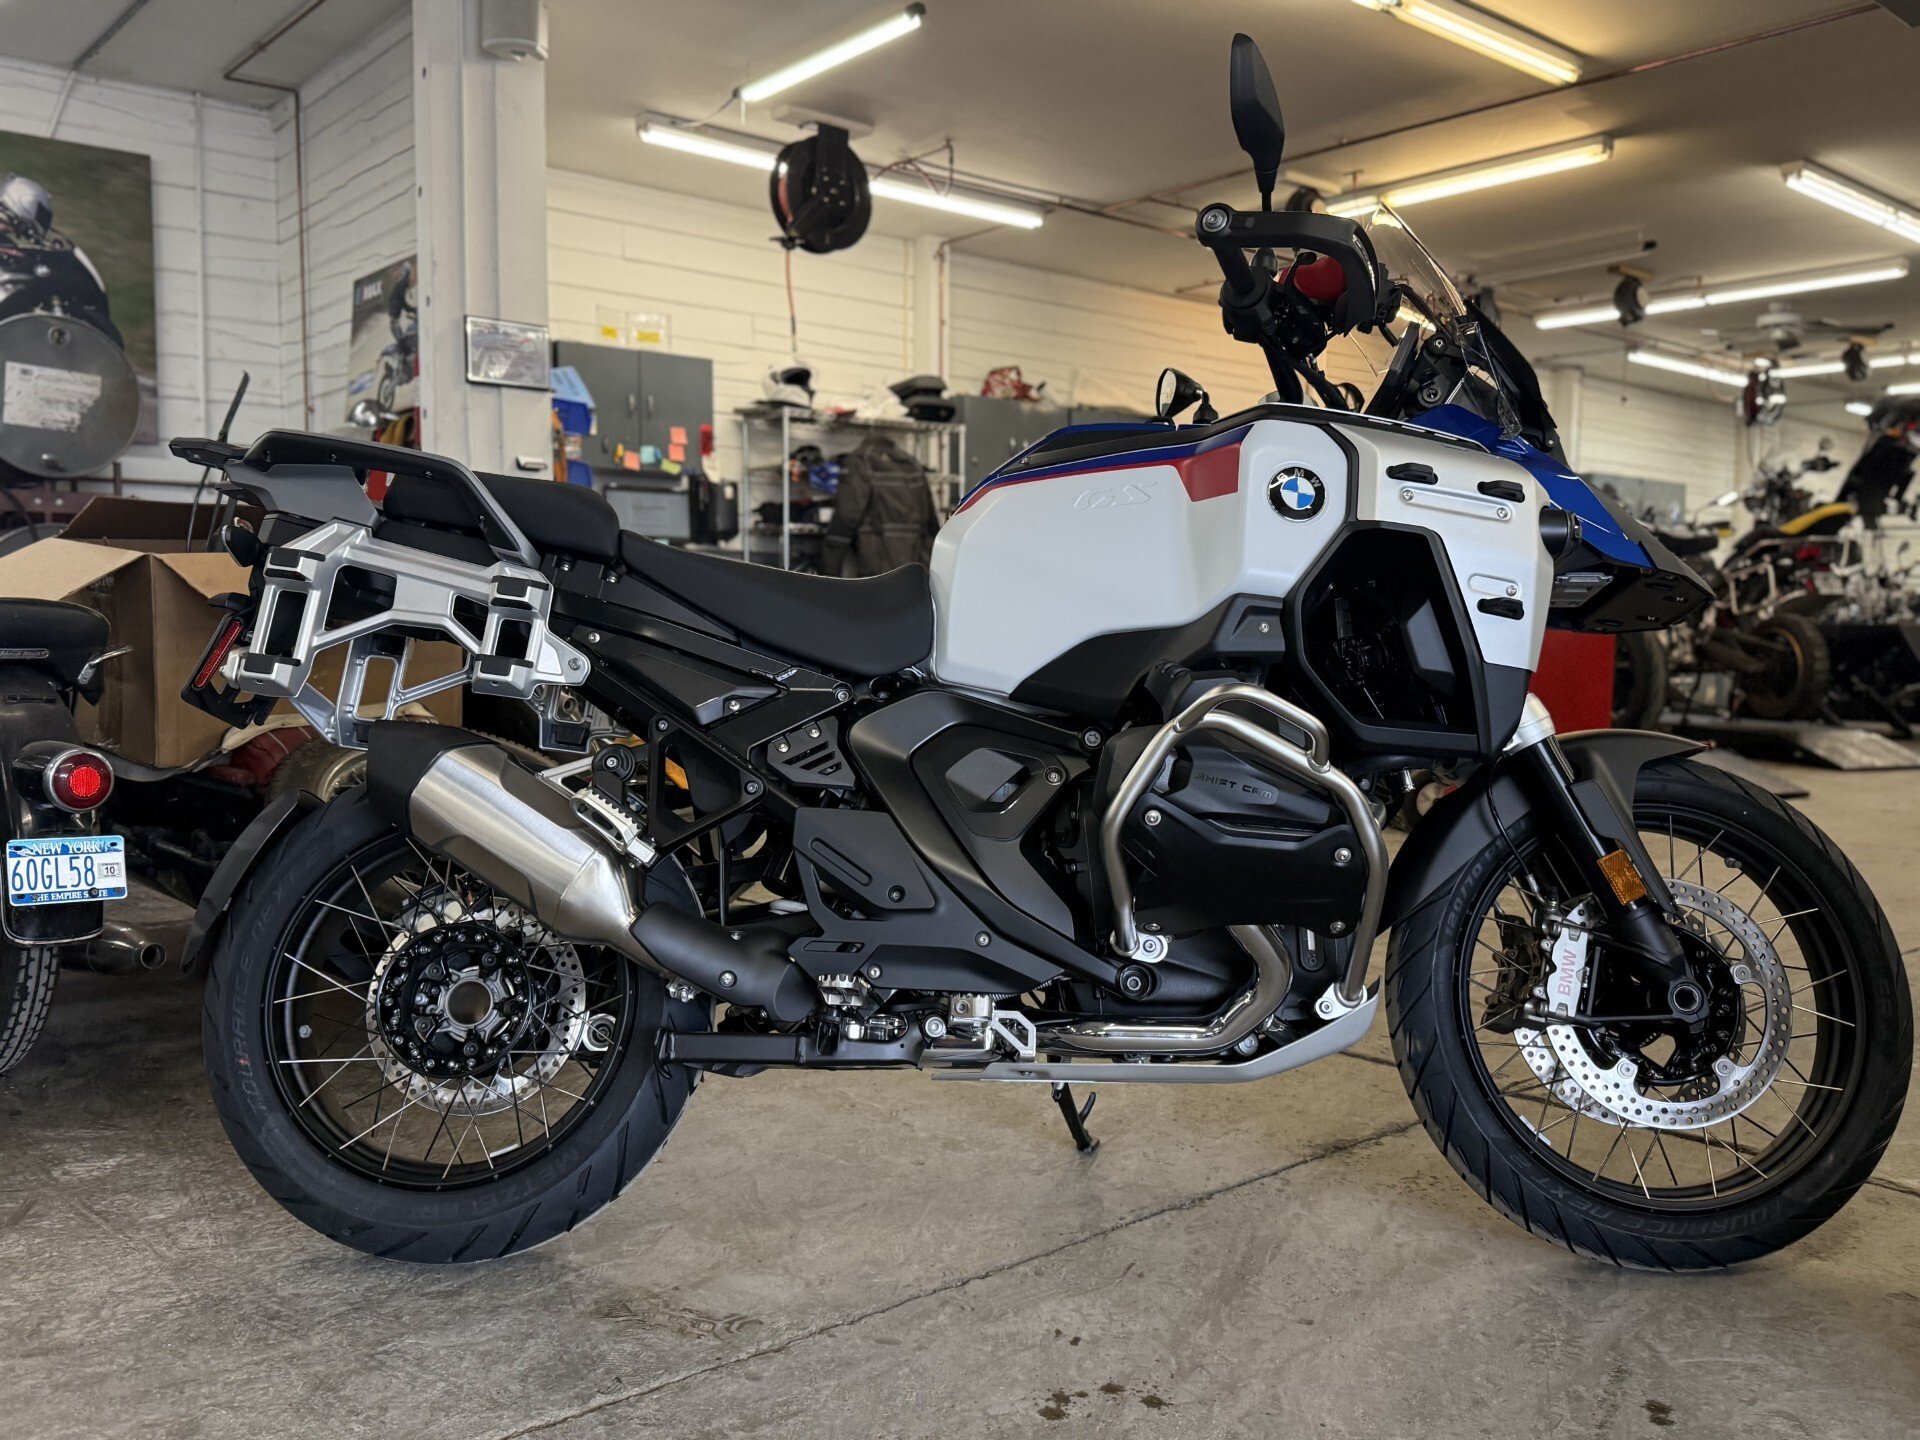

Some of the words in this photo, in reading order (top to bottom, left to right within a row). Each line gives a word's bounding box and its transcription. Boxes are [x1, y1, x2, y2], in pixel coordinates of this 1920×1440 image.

[1277, 467, 1322, 488] BMW
[1074, 481, 1158, 510] GS
[32, 842, 62, 856] NEW
[68, 840, 102, 854] YORK
[11, 855, 96, 892] 60GL58
[104, 866, 115, 875] 10
[51, 891, 82, 900] EMPIRE
[83, 889, 108, 898] STE
[1557, 949, 1577, 996] BMW
[231, 949, 268, 1117] TOURANCE
